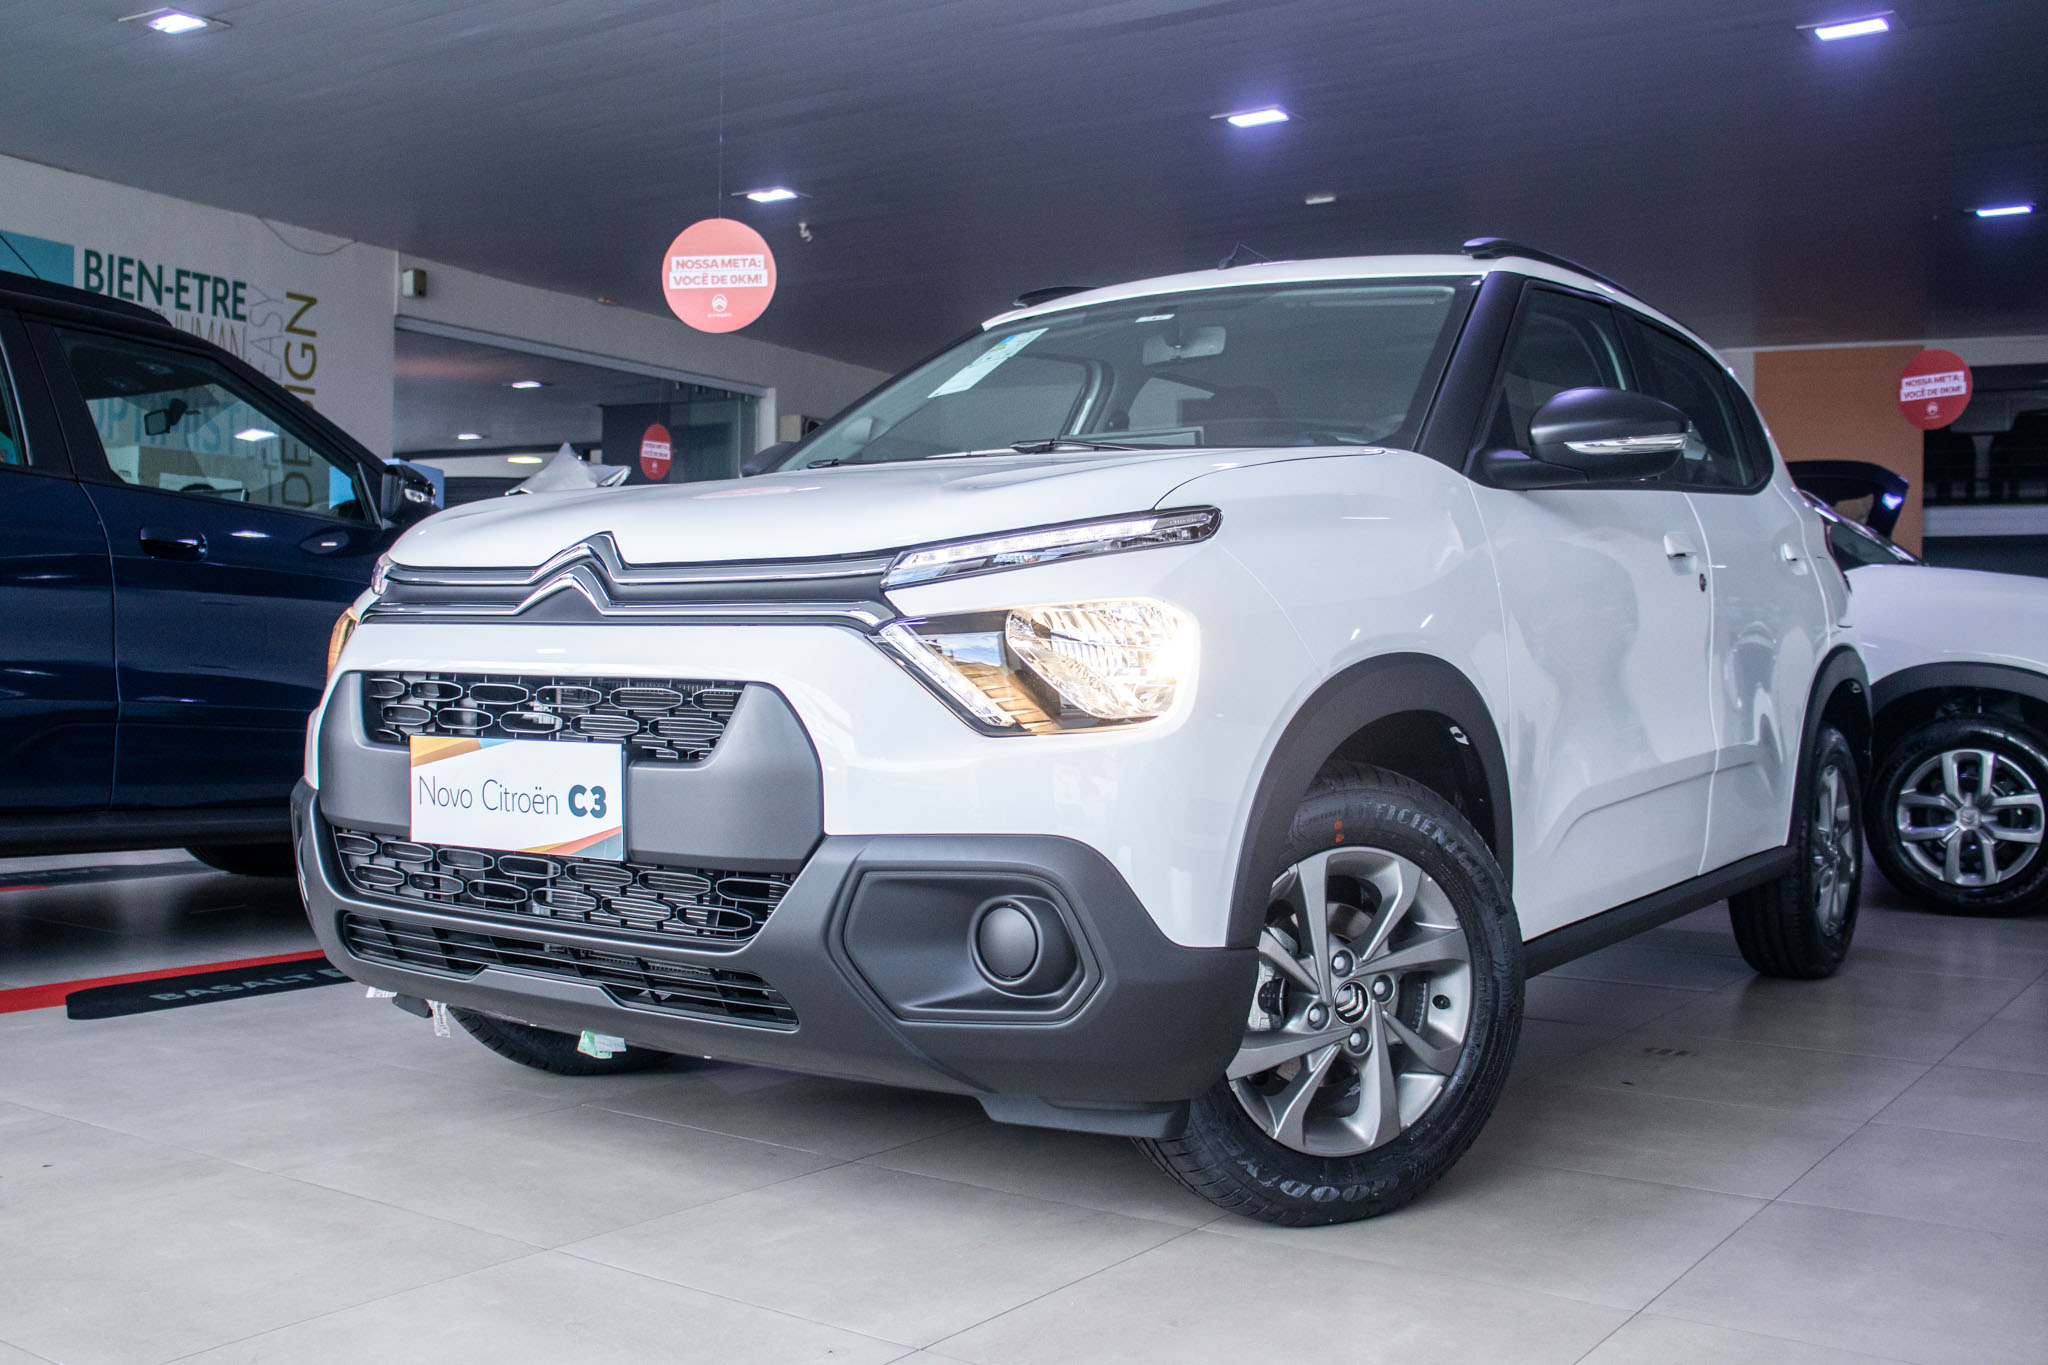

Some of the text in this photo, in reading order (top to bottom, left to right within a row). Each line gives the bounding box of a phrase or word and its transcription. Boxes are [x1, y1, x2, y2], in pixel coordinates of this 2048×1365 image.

[673, 272, 709, 286] VOCÊ
[711, 275, 728, 285] DE
[675, 257, 761, 270] NOSSA META:
[84, 248, 247, 322] BIEN-ETRE
[281, 291, 318, 507] DEIGN
[418, 775, 608, 819] Novo Citroën C3
[150, 973, 314, 1001] BASALT
